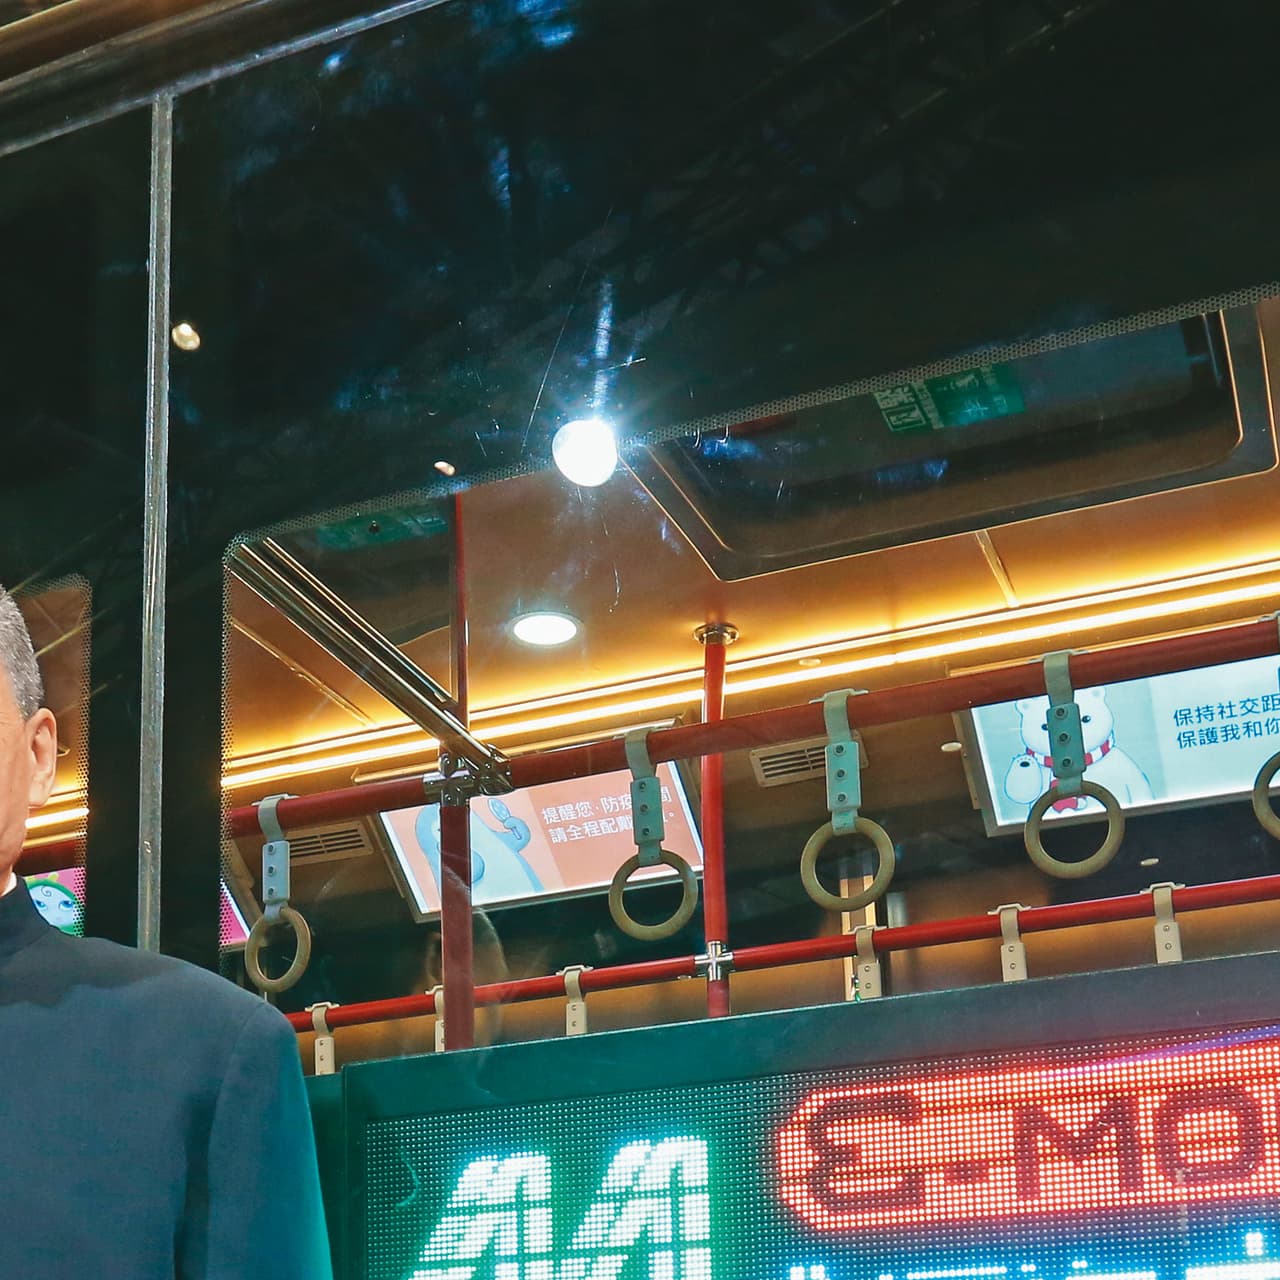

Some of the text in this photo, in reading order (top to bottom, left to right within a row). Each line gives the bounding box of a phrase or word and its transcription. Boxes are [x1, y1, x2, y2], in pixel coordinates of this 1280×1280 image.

[548, 812, 675, 844] 請全程配戴。
